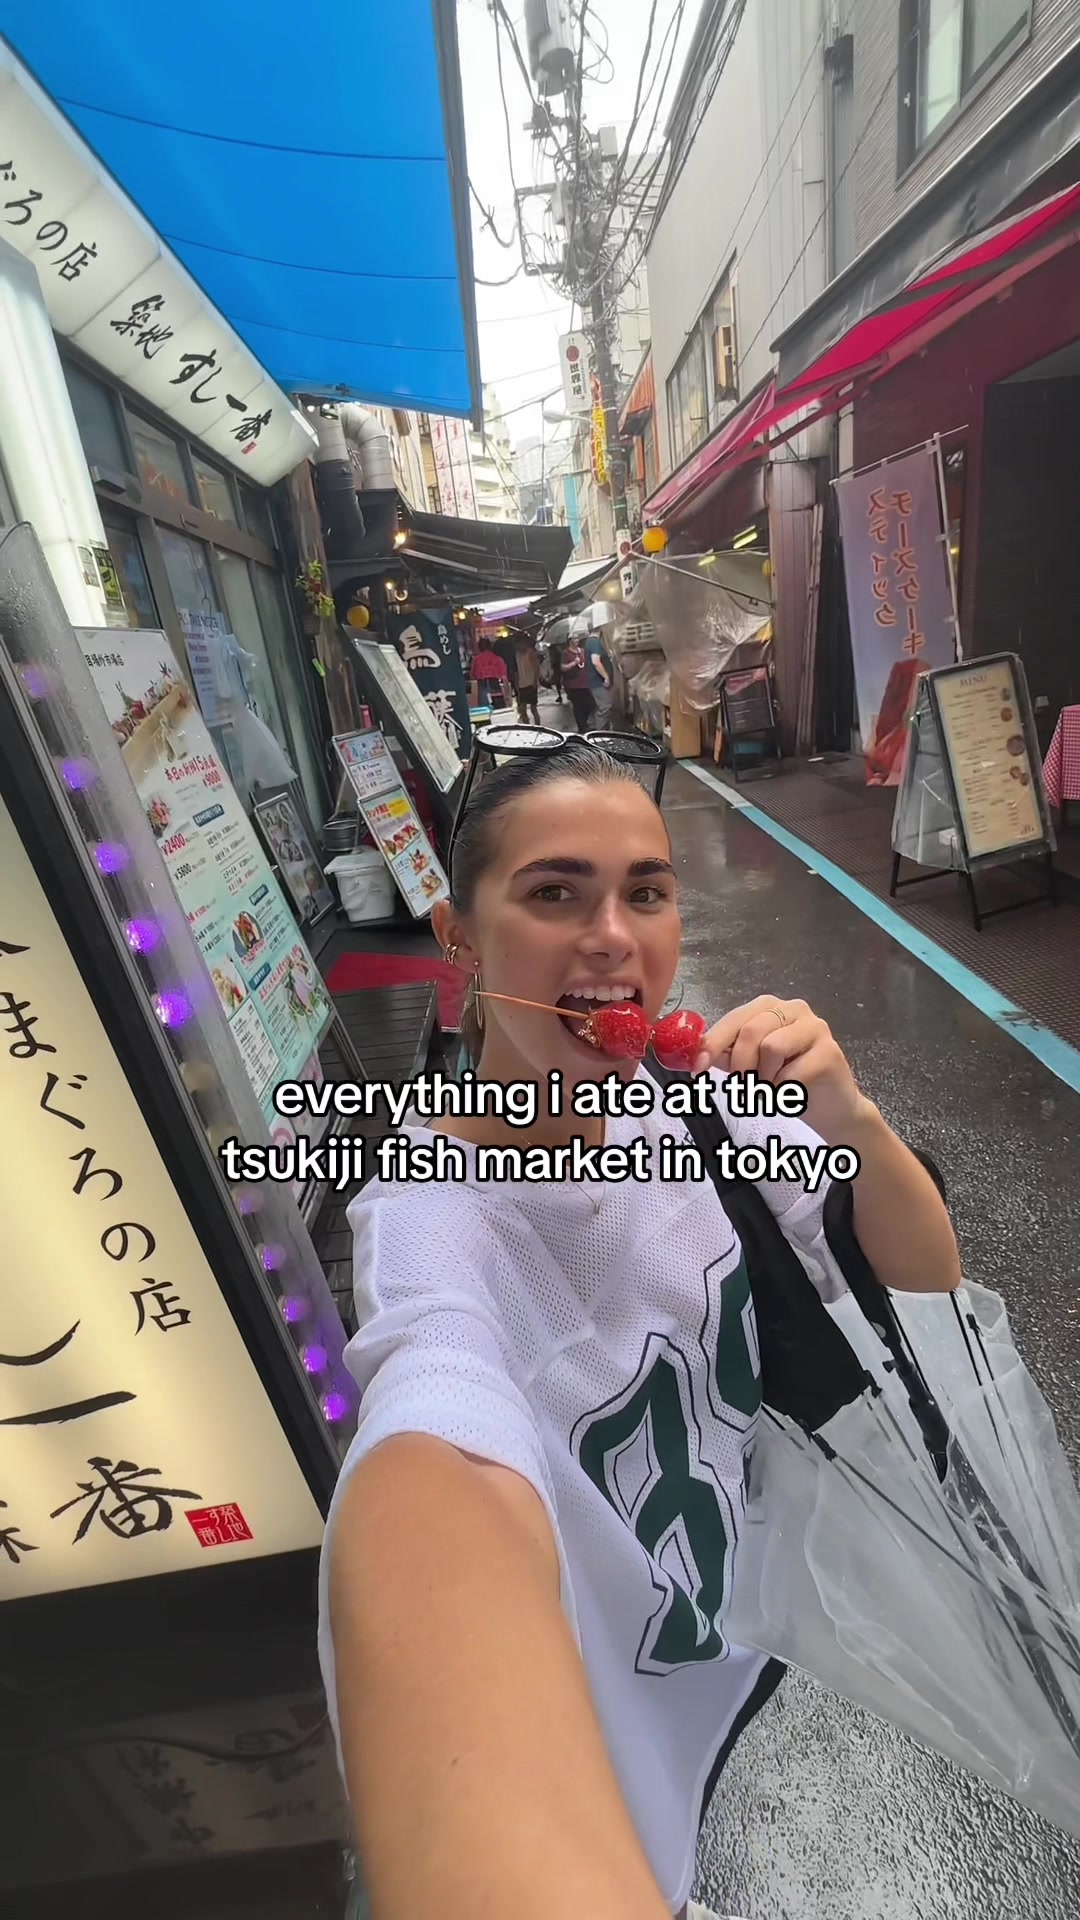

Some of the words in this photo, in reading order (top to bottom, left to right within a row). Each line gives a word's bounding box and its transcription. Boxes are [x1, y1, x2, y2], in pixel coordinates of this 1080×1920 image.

[110, 294, 174, 360] 築地
[169, 348, 274, 445] すし一番
[959, 674, 988, 689] MENU
[161, 832, 186, 857] ¥2400
